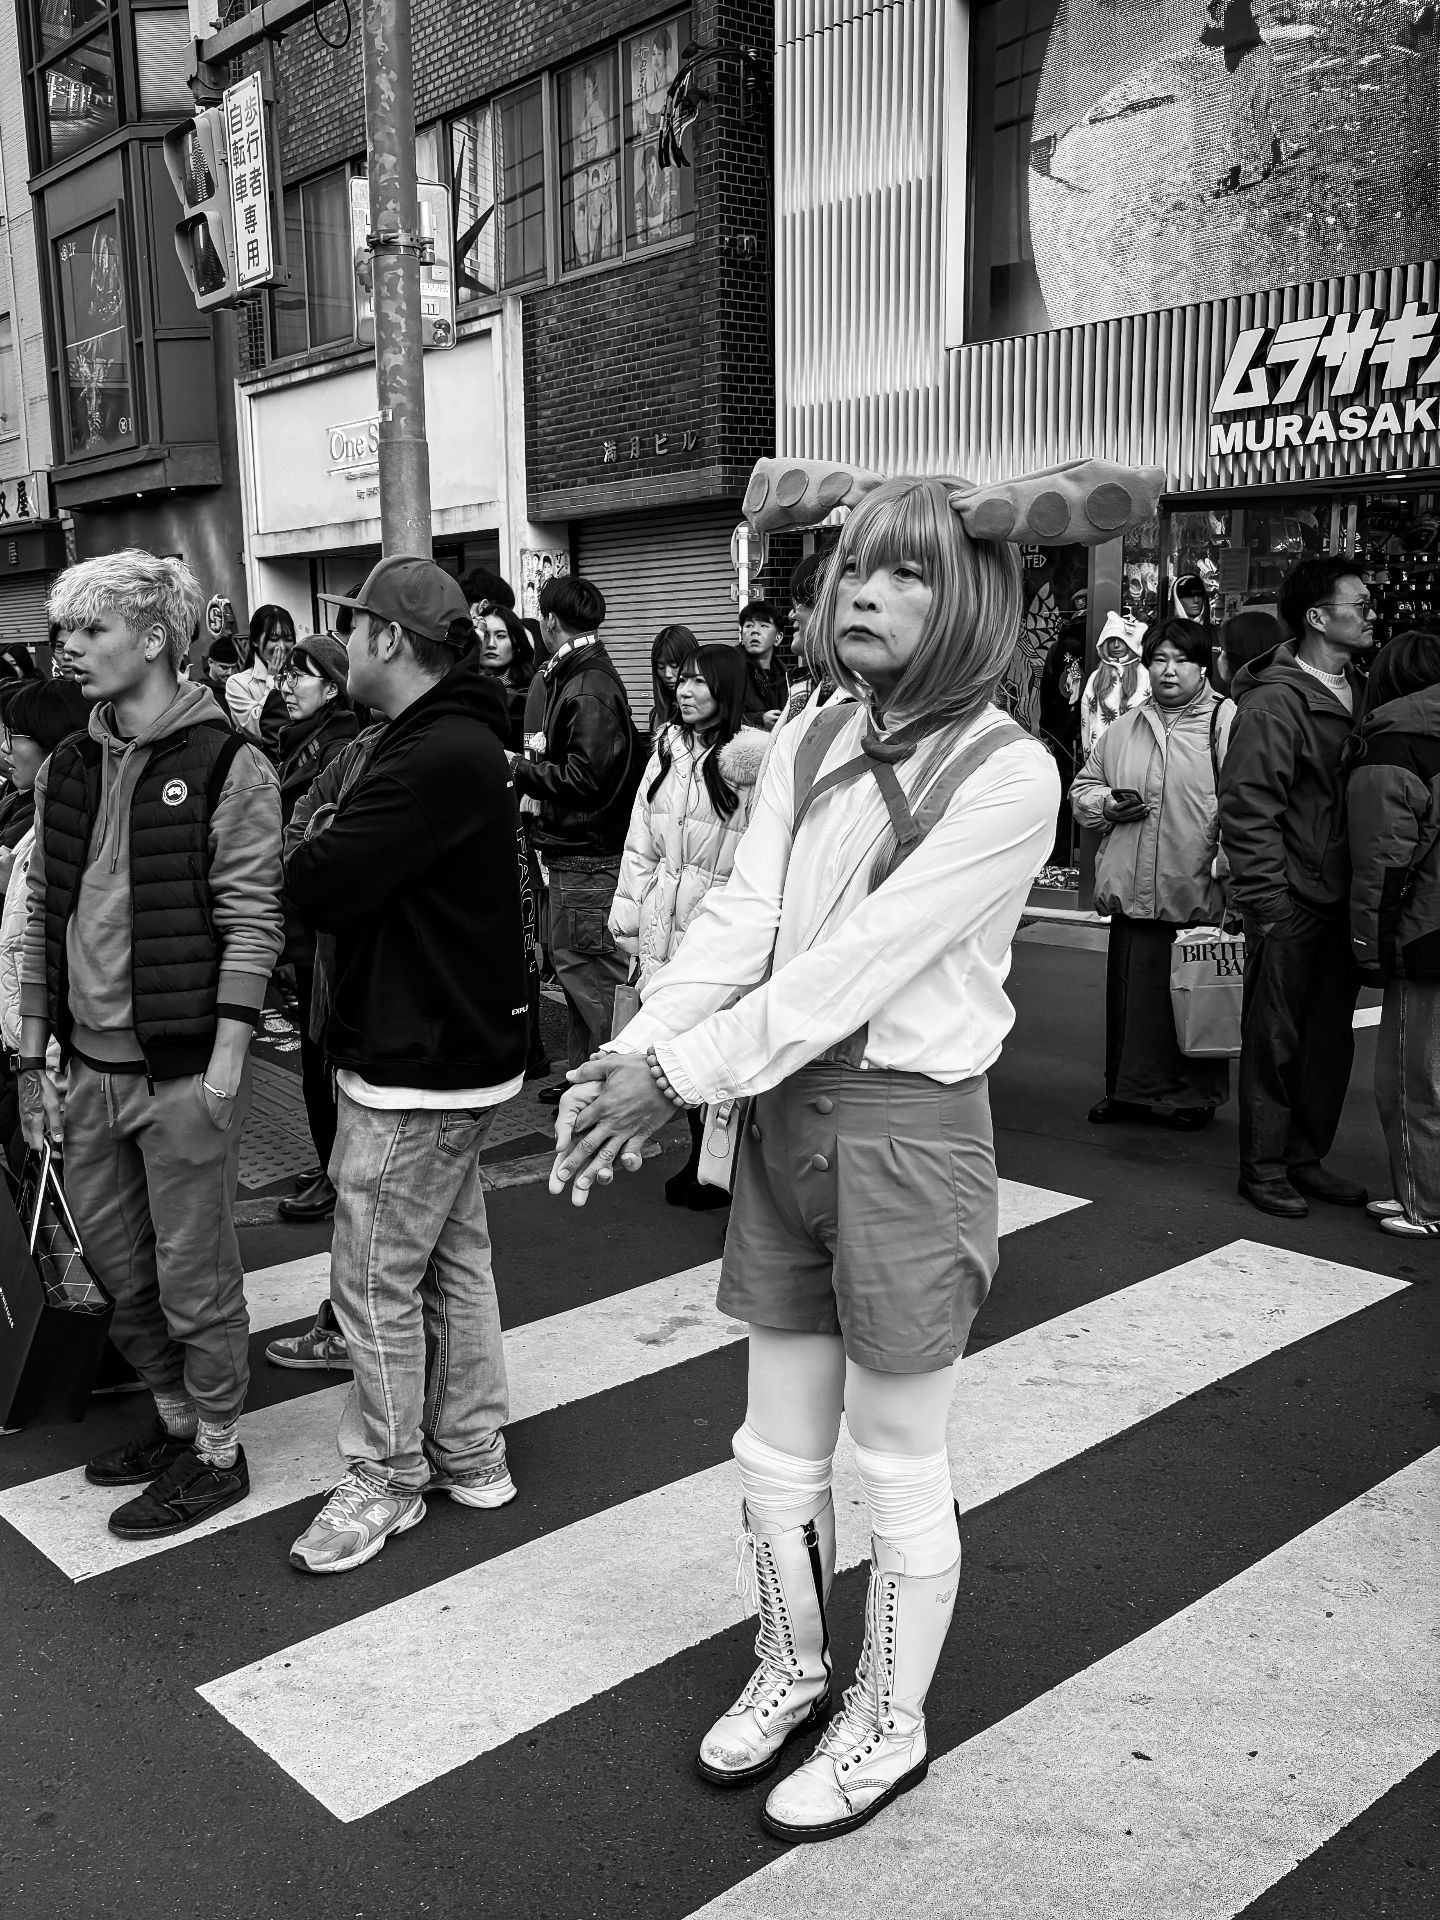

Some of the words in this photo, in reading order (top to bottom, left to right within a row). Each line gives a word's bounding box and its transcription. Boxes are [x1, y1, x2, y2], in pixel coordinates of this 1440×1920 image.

[229, 103, 248, 204] 自転車
[244, 95, 262, 198] 歩行者
[243, 203, 260, 271] 専用
[330, 432, 365, 461] One
[1209, 396, 1440, 456] MURASAK
[1022, 554, 1047, 568] ITED
[1182, 942, 1246, 963] BIRTH
